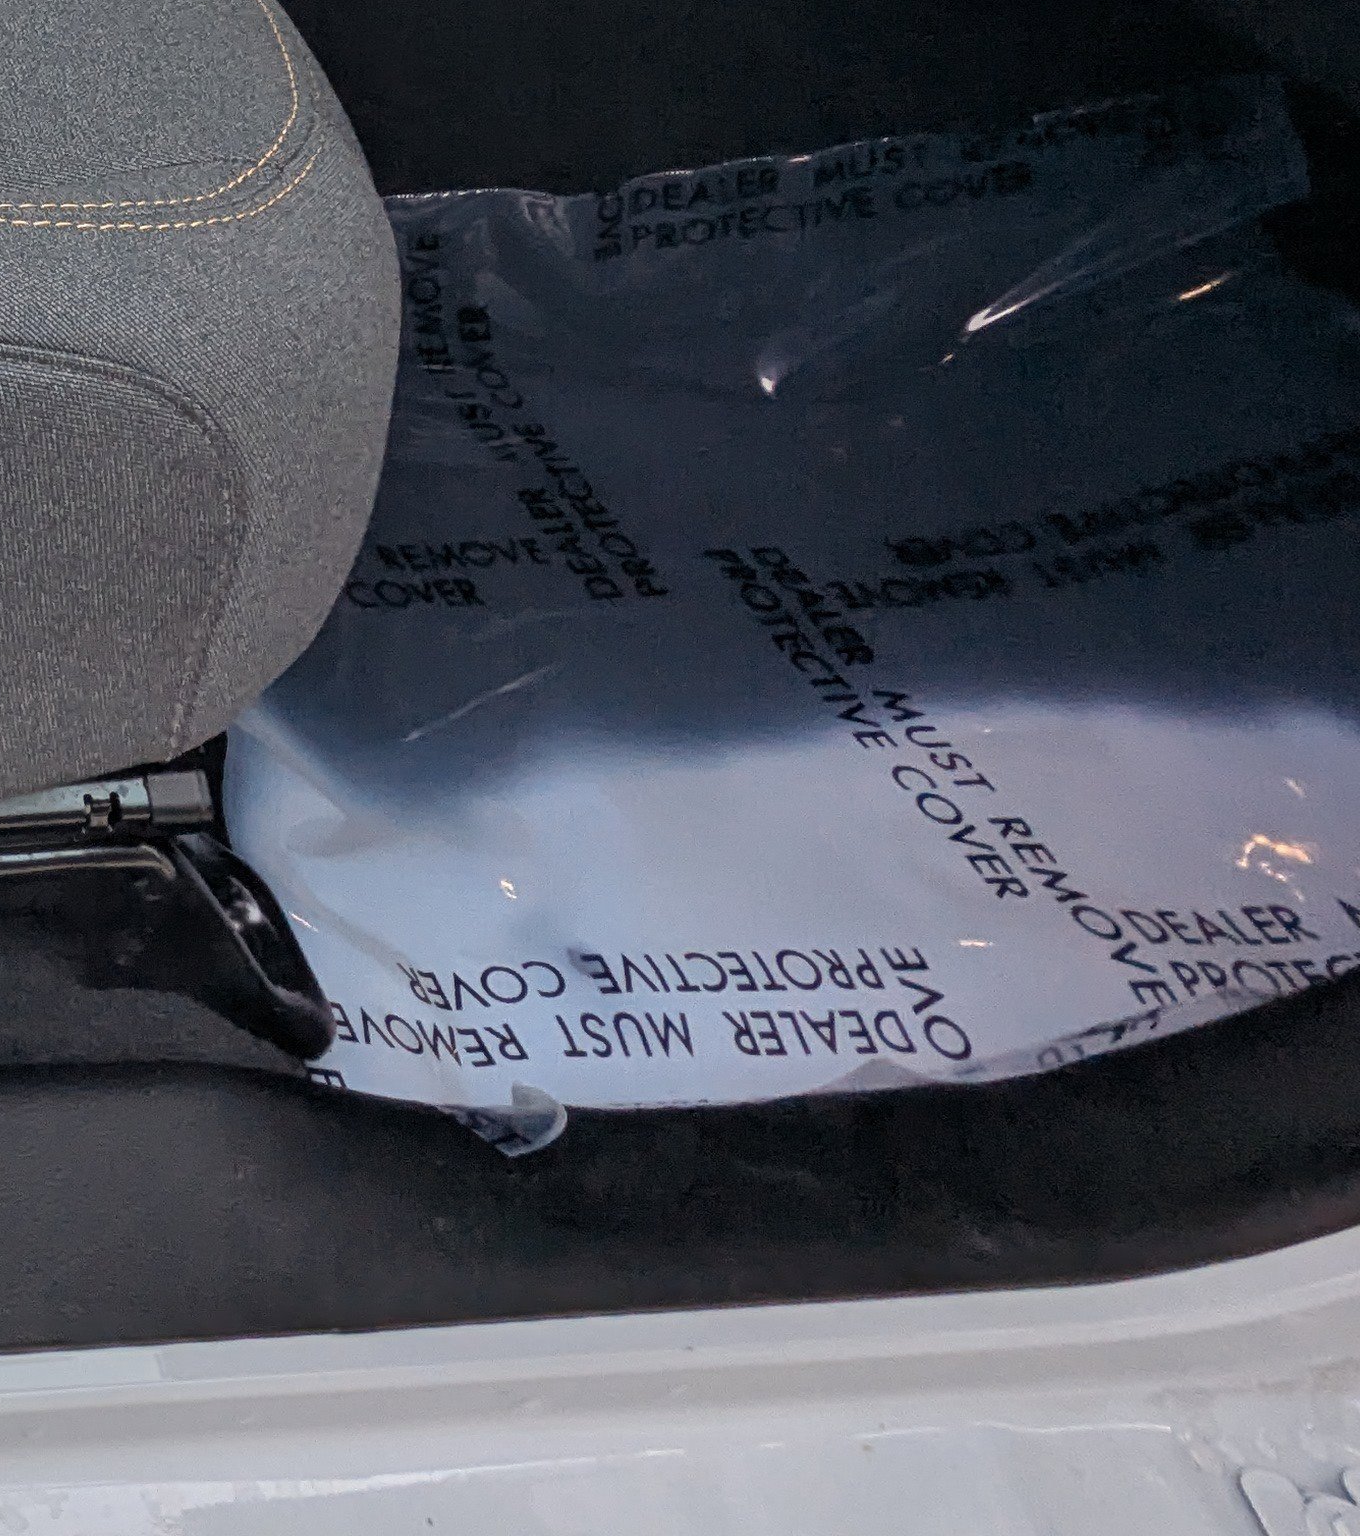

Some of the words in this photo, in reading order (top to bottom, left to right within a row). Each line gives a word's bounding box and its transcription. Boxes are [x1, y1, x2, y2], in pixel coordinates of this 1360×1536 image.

[631, 166, 778, 214] DEALER
[631, 186, 877, 250] PROTECTIVE
[893, 162, 1032, 211] COVER
[376, 537, 550, 571] REMOVE
[344, 578, 486, 609] COVER
[702, 547, 899, 750] PROTECTIVE
[891, 765, 1030, 900] COVER
[750, 546, 876, 666] DEALER
[872, 690, 996, 793] MUST
[987, 816, 1179, 1005] REMOVE
[1120, 904, 1322, 947] DEALER
[396, 960, 567, 1011] COVER
[580, 948, 887, 995] PROTECTIVE
[329, 1001, 531, 1068] REMOVE
[555, 1011, 695, 1059] MUST
[721, 1010, 919, 1057] DEALER
